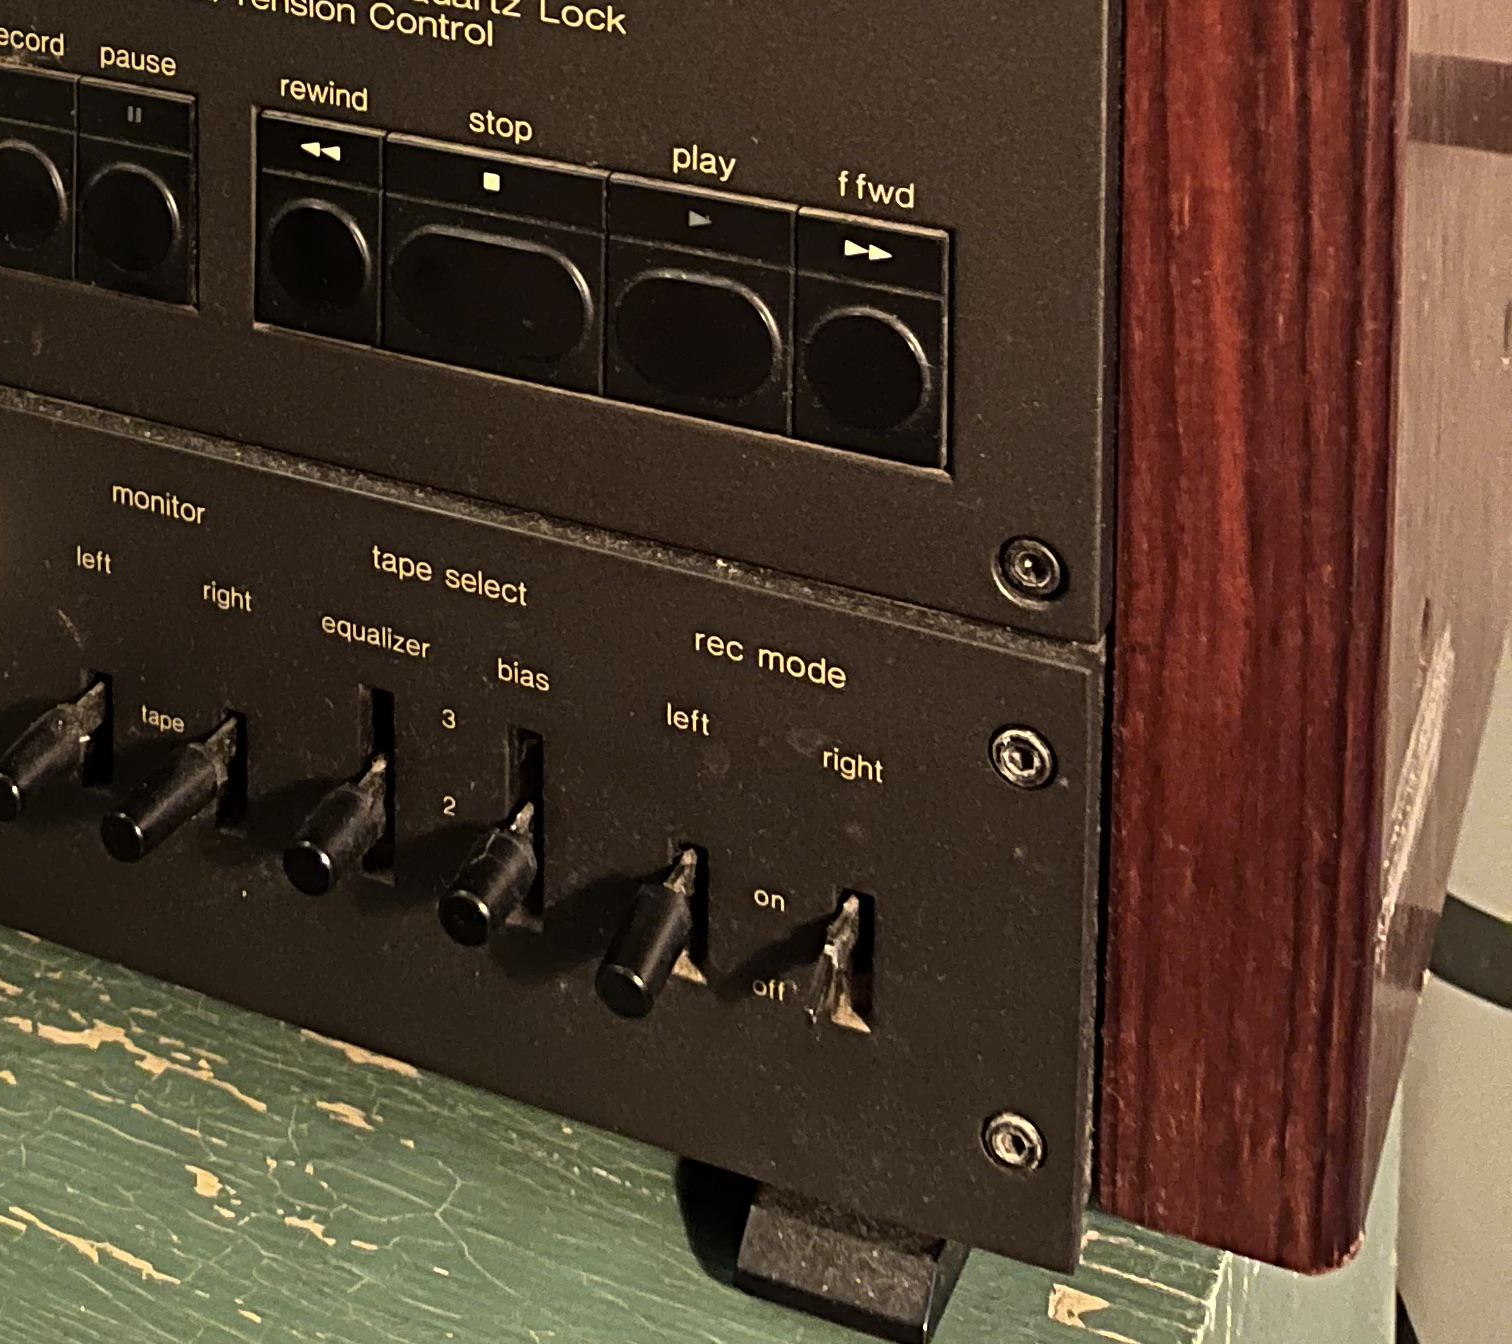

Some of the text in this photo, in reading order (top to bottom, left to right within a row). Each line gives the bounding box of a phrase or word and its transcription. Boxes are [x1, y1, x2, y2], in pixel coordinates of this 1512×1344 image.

[369, 2, 495, 48] Control
[99, 42, 178, 78] pause
[279, 75, 370, 112] rewind
[468, 110, 534, 144] stop
[672, 143, 737, 182] play
[111, 483, 206, 525] monitor
[75, 545, 253, 612] left right
[372, 544, 529, 607] tape select
[320, 613, 432, 659] equalizer
[496, 657, 551, 693] bias
[693, 631, 848, 690] rec mode
[141, 704, 186, 734] tape
[440, 708, 457, 731] 3
[666, 702, 885, 785] left right
[441, 795, 457, 817] 2
[753, 886, 787, 913] on
[751, 975, 789, 1003] off
